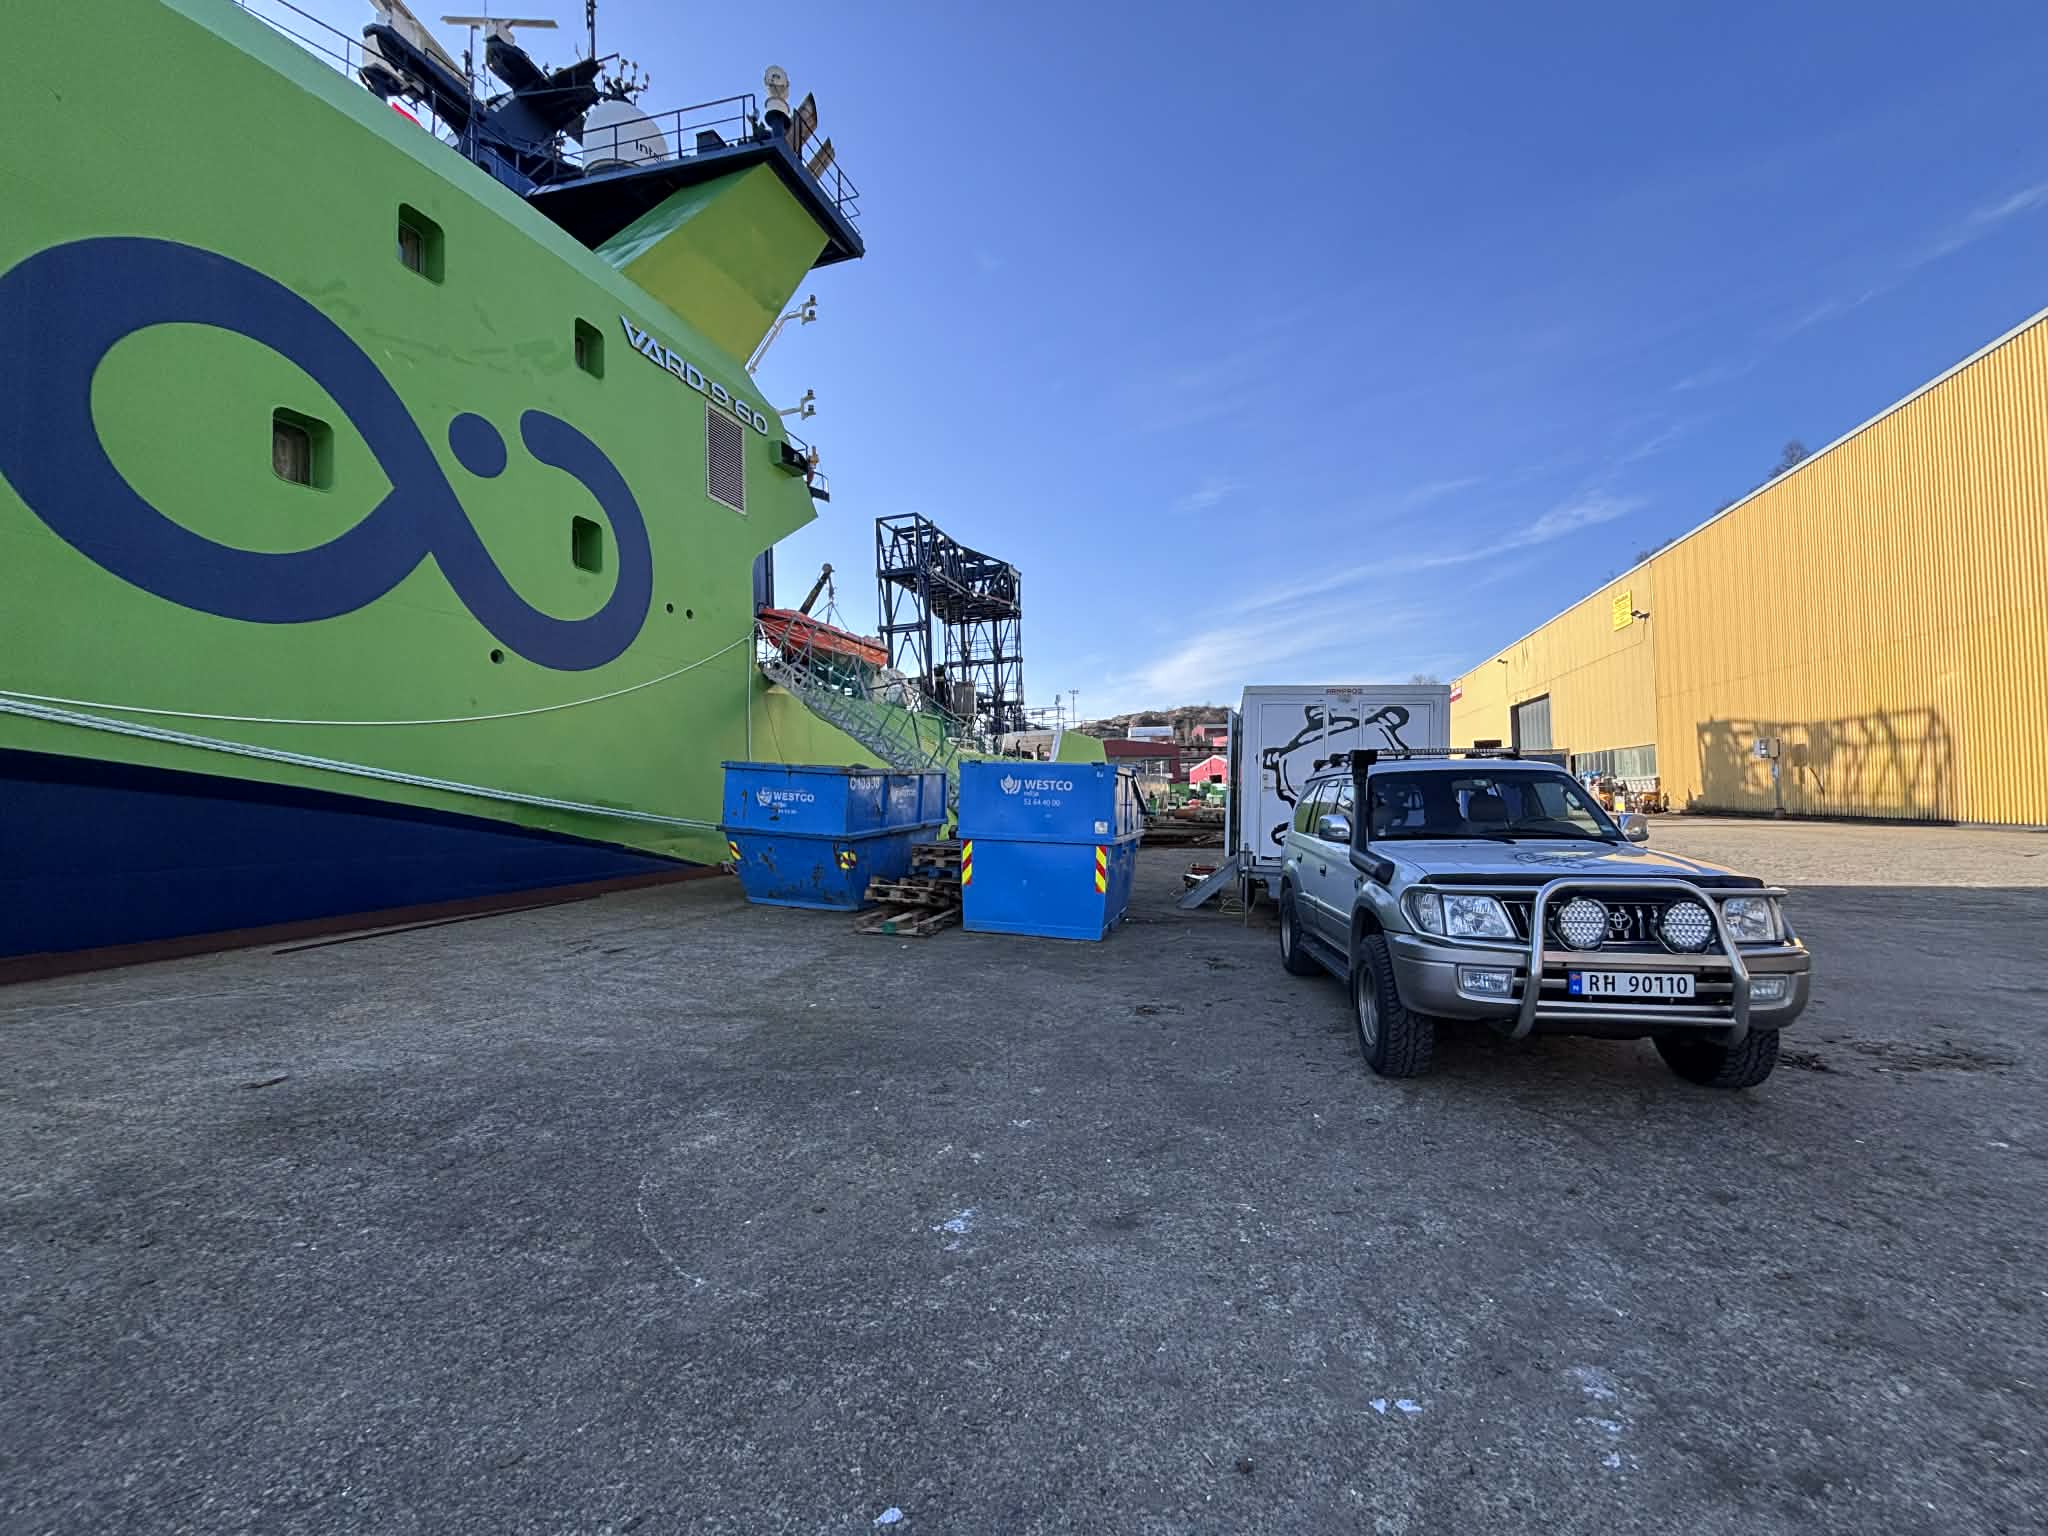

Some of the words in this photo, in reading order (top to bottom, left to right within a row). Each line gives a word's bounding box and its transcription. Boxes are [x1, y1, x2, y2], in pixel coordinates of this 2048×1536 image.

[619, 312, 705, 391] VARD
[711, 382, 729, 406] 9
[734, 399, 769, 436] 60
[1023, 779, 1073, 792] WESTCO
[773, 791, 815, 803] WESTCO
[1589, 974, 1616, 993] RH
[1628, 975, 1688, 995] 90110
